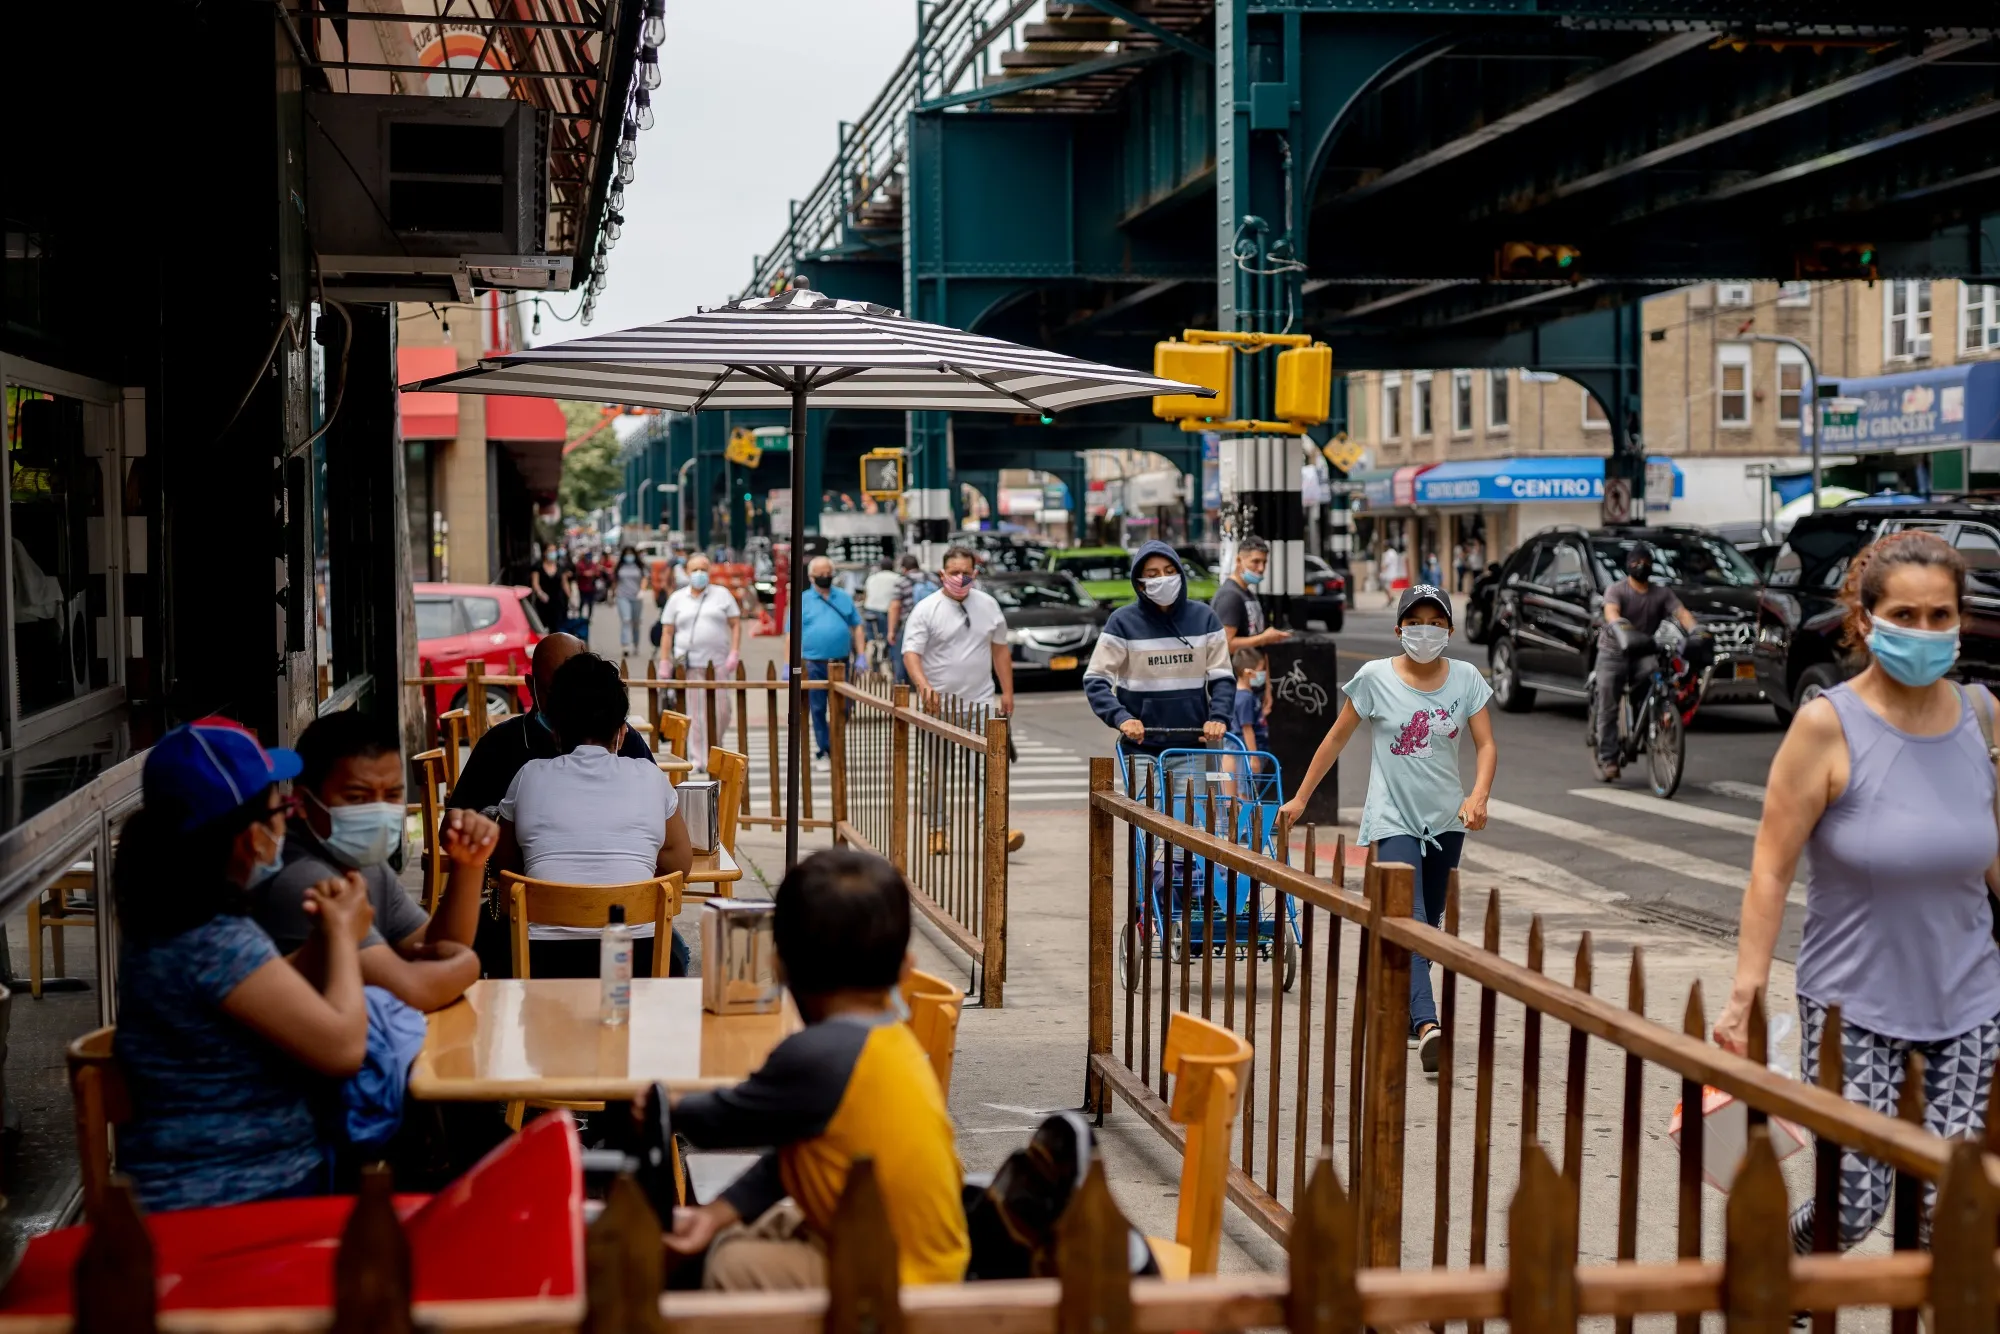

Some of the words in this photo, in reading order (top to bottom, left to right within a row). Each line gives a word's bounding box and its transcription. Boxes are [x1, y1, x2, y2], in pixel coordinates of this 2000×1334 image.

[1870, 411, 1938, 438] GROCERY
[1511, 478, 1591, 498] CENTRO
[1413, 584, 1439, 598] NY
[1147, 653, 1195, 666] HOLLISTER
